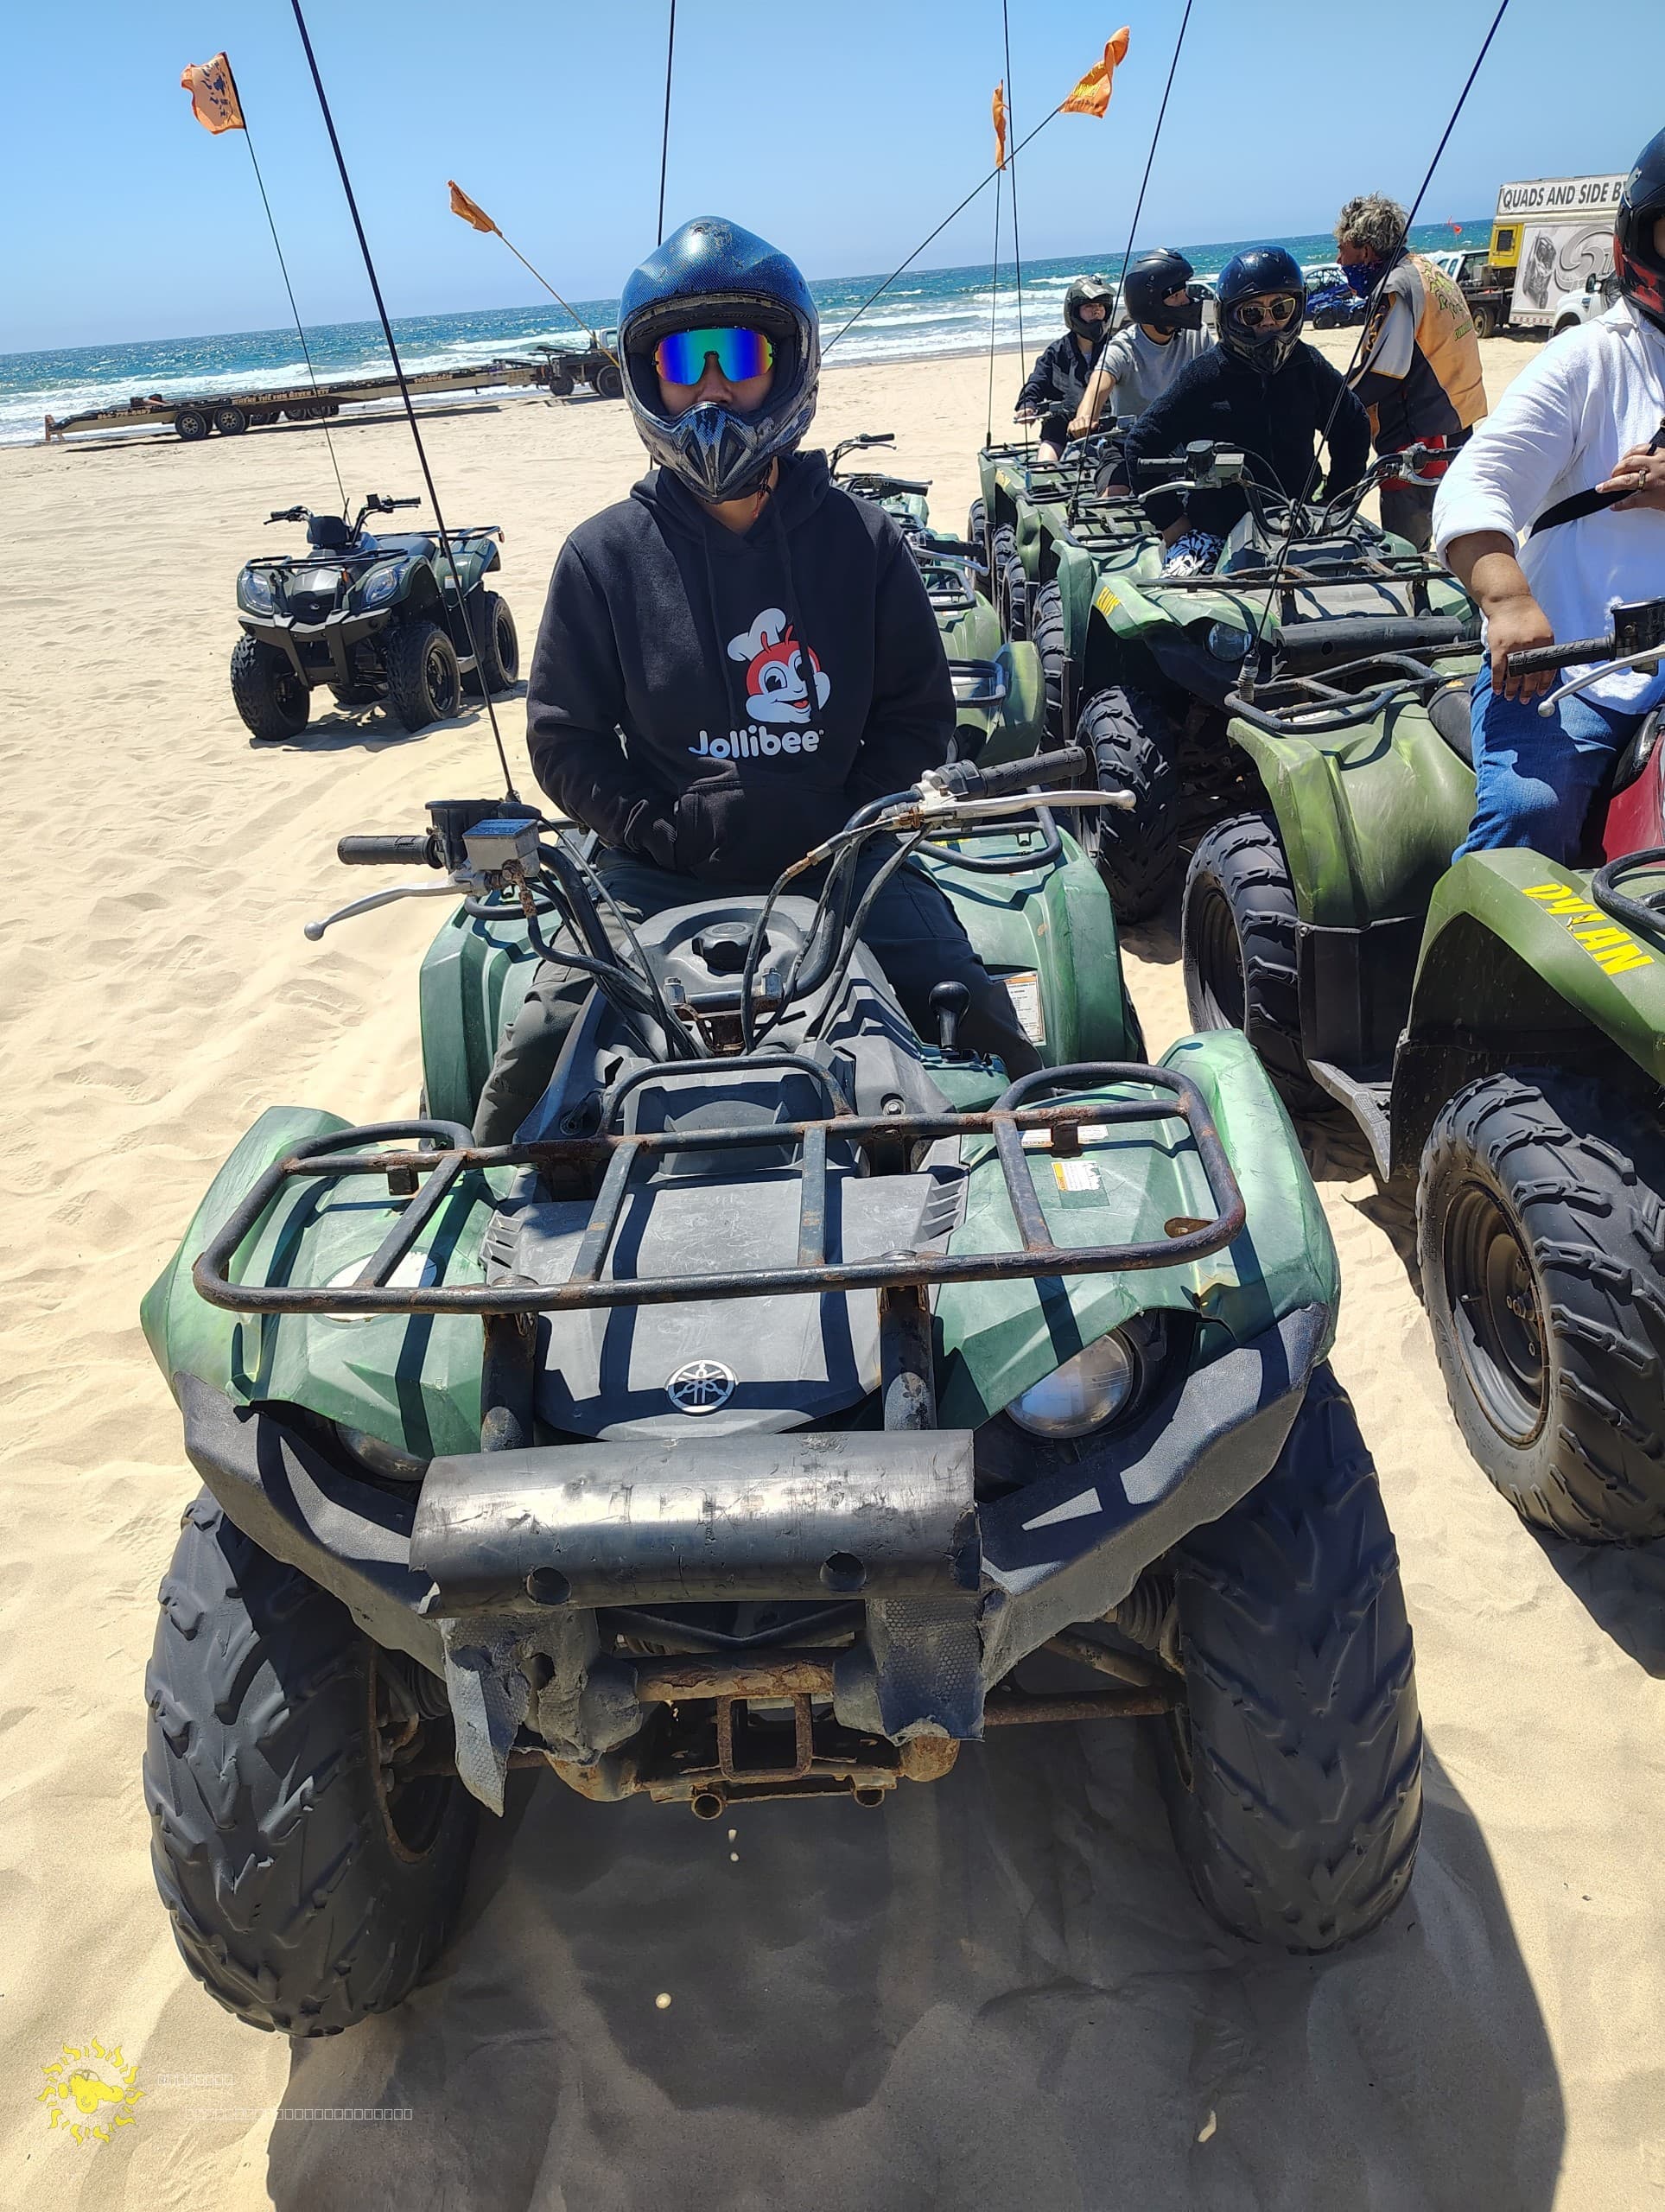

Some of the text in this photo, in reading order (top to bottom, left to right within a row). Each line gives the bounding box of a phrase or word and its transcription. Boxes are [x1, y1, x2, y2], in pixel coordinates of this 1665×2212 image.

[1503, 181, 1626, 209] QUADS AND SIDE B
[688, 725, 820, 759] Jollibee
